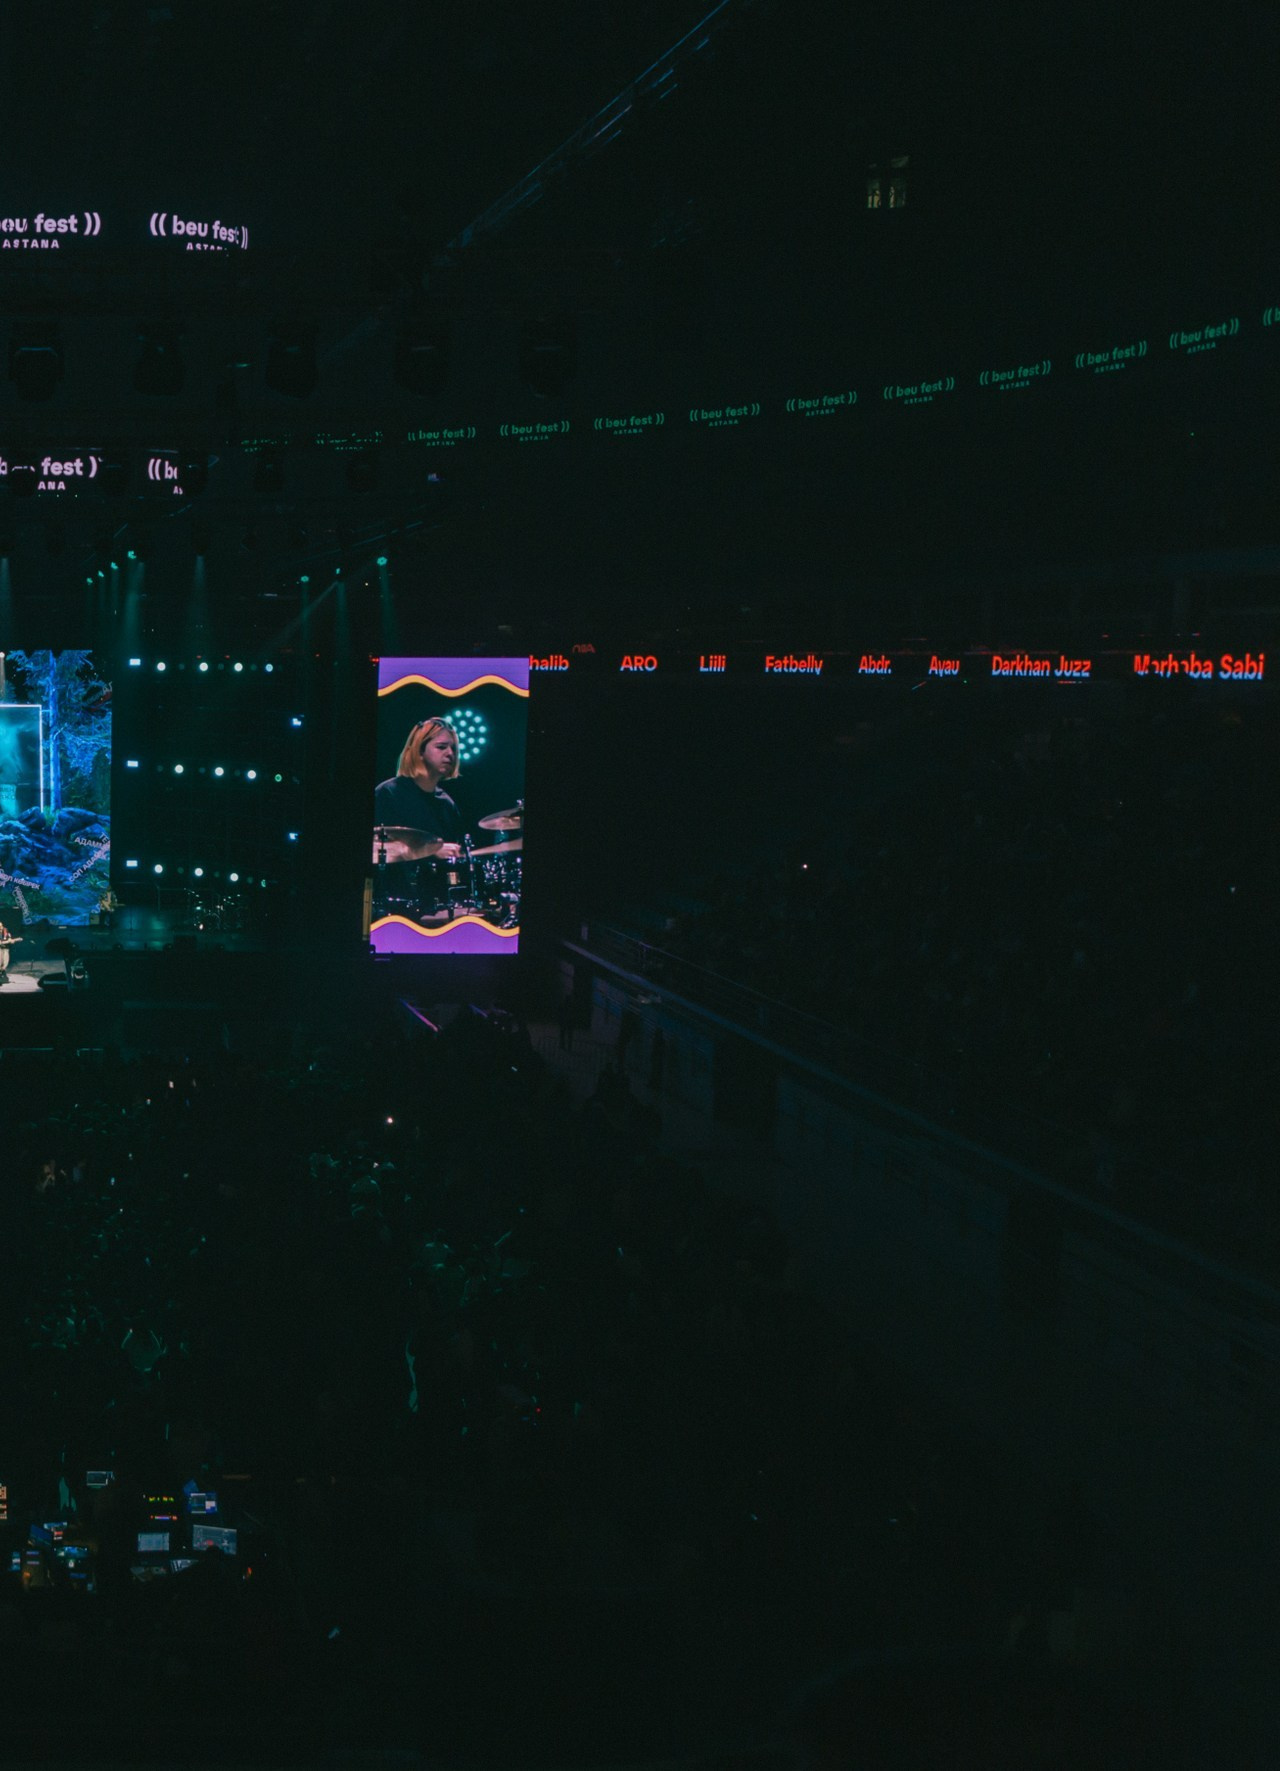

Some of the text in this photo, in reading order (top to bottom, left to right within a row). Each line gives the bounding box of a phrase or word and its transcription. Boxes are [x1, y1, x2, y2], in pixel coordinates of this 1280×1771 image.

[34, 213, 78, 233] fest
[172, 214, 208, 237] beu
[2, 238, 60, 249] ASTANA
[41, 457, 84, 476] fest
[529, 654, 570, 671] halib
[620, 655, 658, 671] ARO
[765, 655, 823, 676] Fatbelly
[858, 655, 892, 674] Abdr.
[928, 655, 960, 677] Ayau
[992, 654, 1092, 678] Darkhan Juzz
[1218, 652, 1266, 680] Sabi
